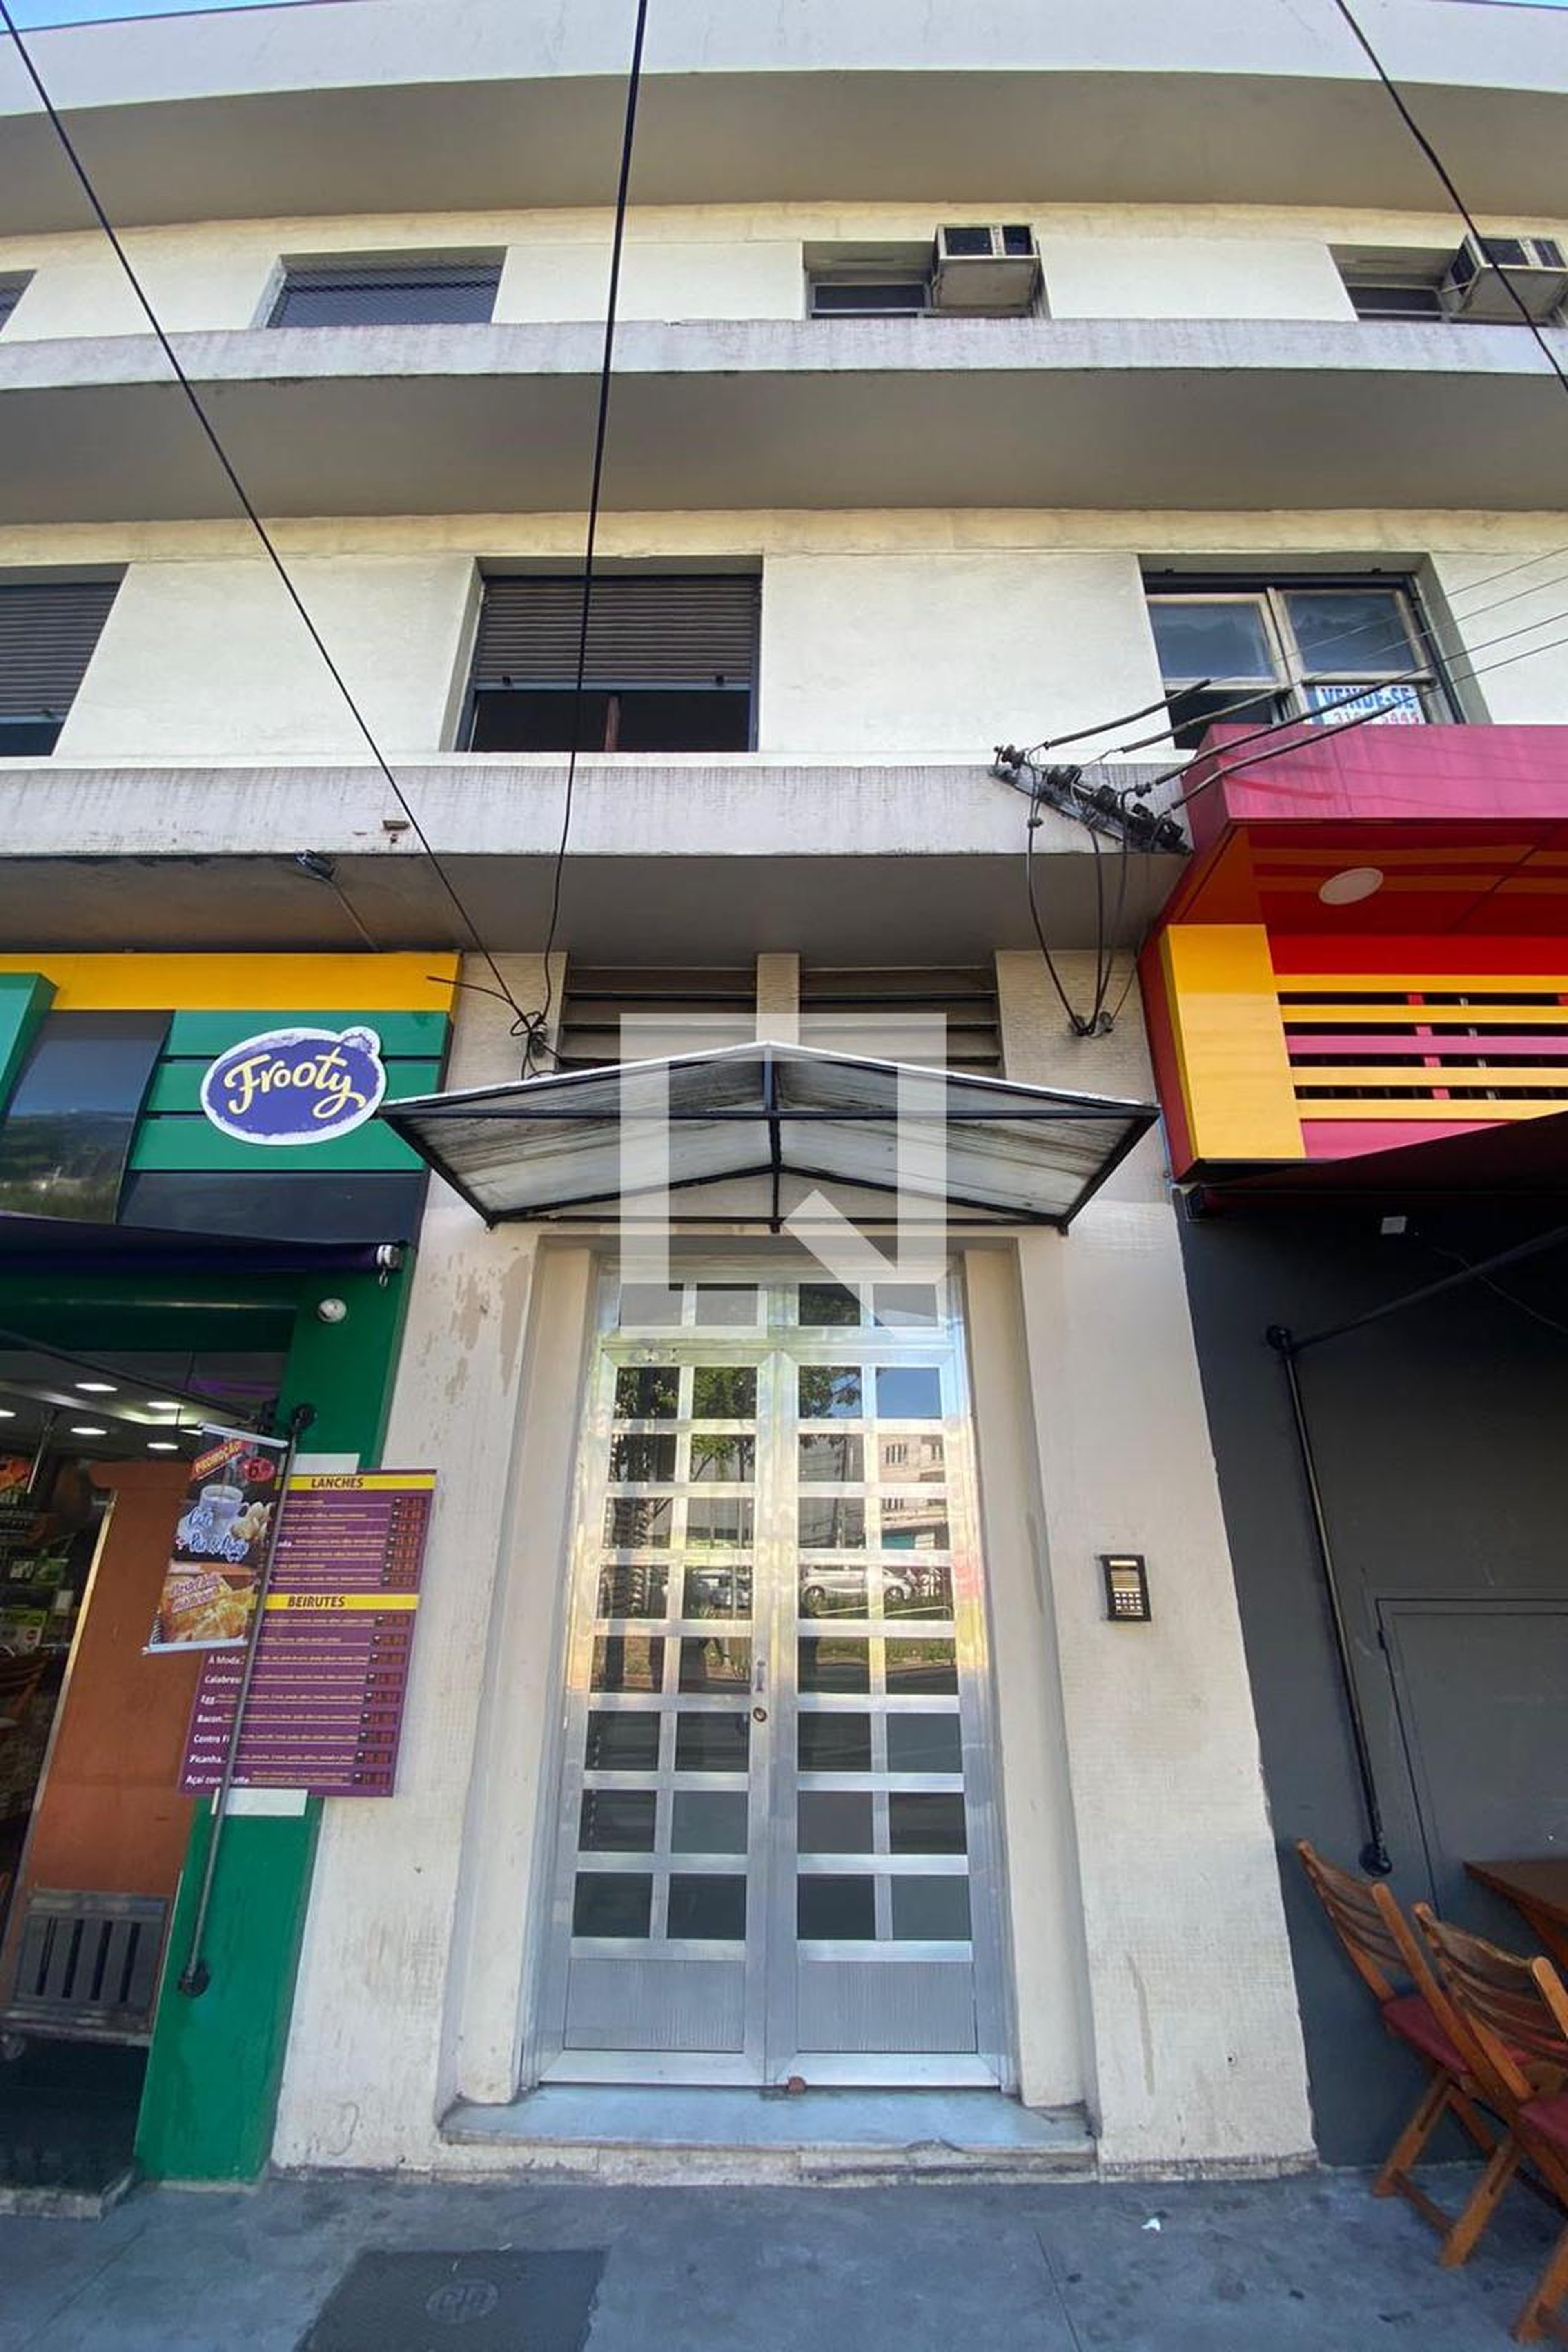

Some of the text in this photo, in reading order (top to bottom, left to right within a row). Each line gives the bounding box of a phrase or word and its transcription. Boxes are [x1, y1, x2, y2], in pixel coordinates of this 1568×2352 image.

[224, 1046, 367, 1118] Frooty
[311, 1477, 364, 1488] LANCHES
[287, 1596, 346, 1608] BEIRUTES
